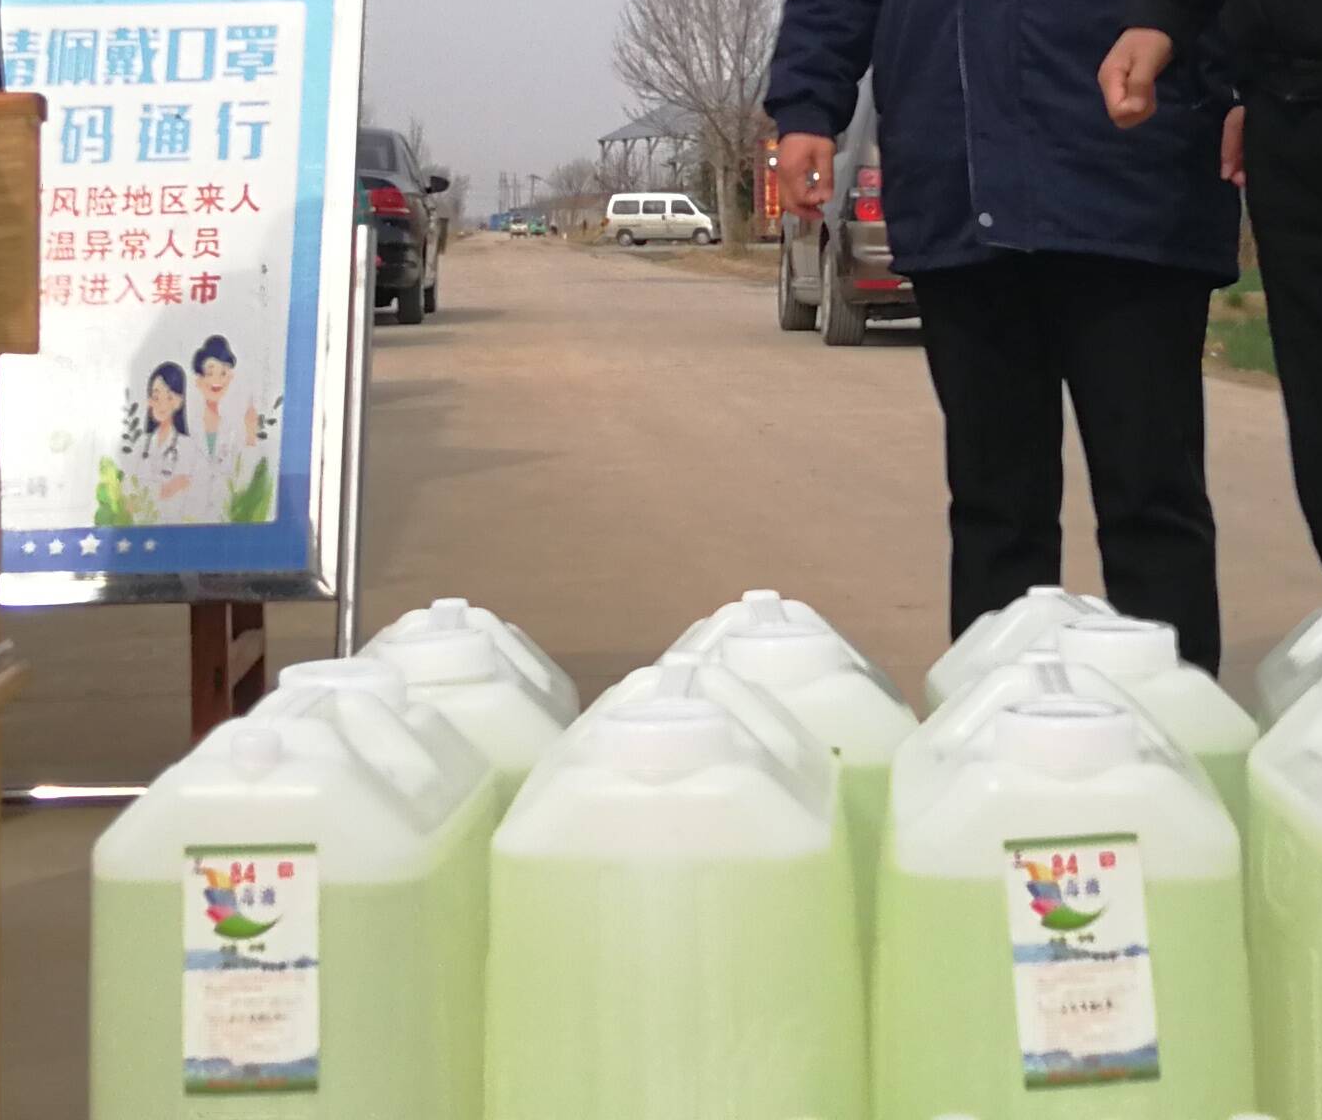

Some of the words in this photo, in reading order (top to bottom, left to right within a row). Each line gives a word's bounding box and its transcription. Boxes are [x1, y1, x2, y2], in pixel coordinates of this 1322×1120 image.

[4, 25, 278, 85] 请佩戴口罩
[60, 101, 271, 164] 码通行
[50, 183, 261, 217] 风险地区来人
[45, 227, 222, 261] 温异常人员
[42, 271, 222, 306] 得进入集市
